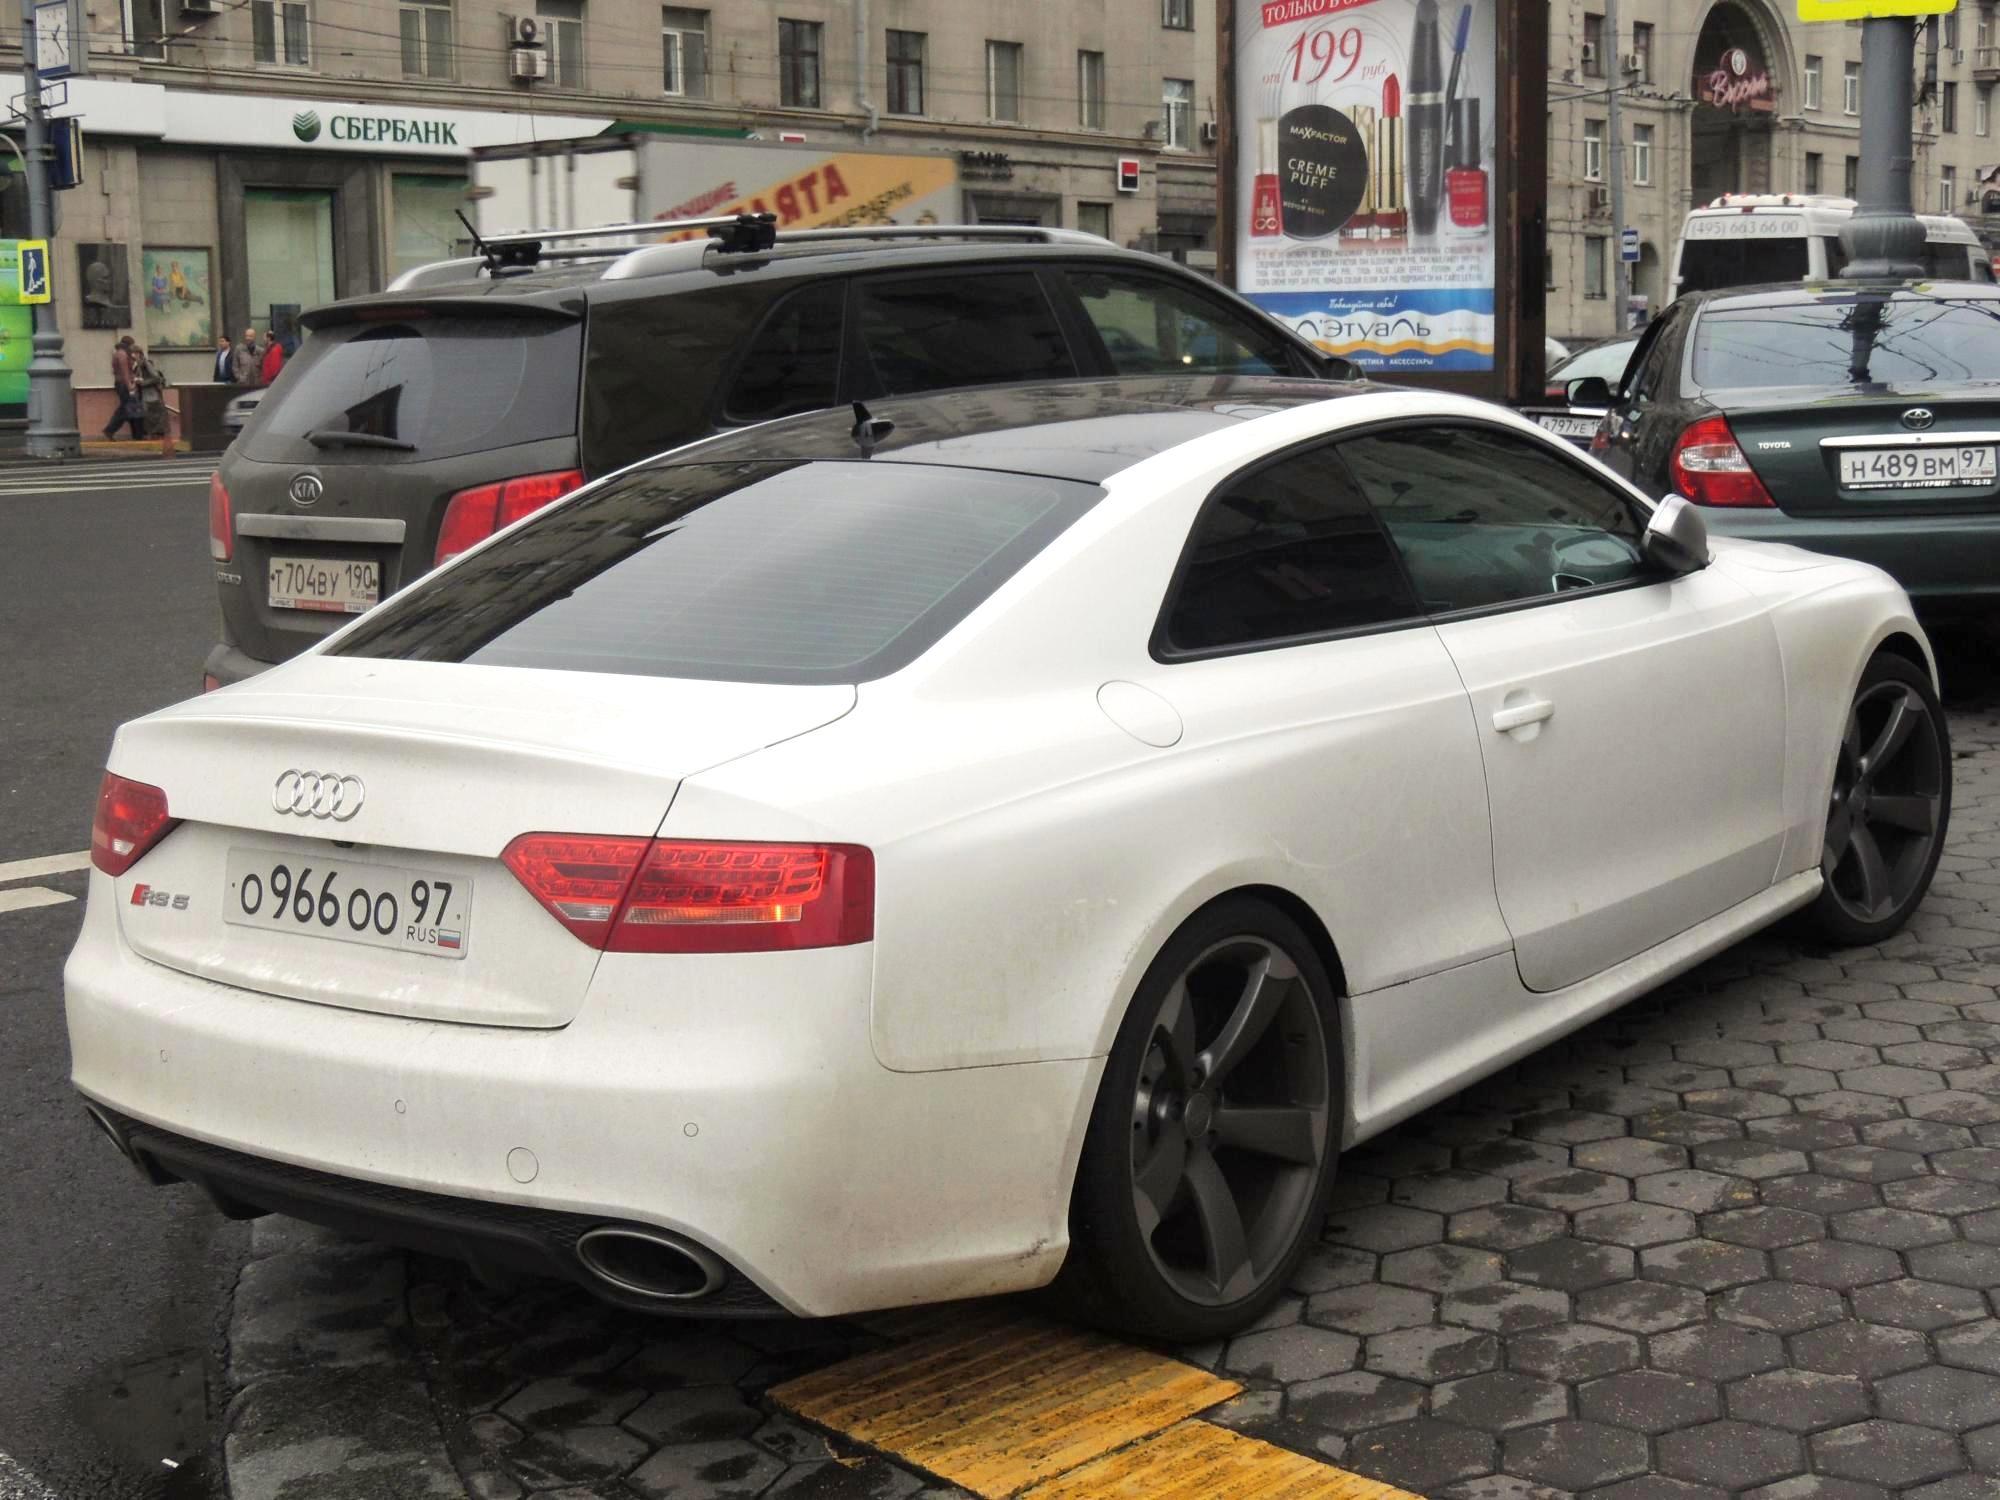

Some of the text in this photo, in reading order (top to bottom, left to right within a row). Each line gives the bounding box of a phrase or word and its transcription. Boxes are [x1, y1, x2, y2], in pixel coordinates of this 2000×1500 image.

[1265, 0, 1325, 24] ТОЛЬКО
[1286, 27, 1362, 85] 199
[330, 115, 458, 145] СБЕРБАНК
[1287, 158, 1337, 179] CREME
[1290, 172, 1329, 190] PUFF
[1758, 441, 1791, 450] TOYOTA
[1961, 449, 1986, 468] 97
[294, 482, 316, 498] KIA
[345, 563, 373, 589] 190
[411, 880, 453, 926] 97
[407, 926, 437, 944] RUS
